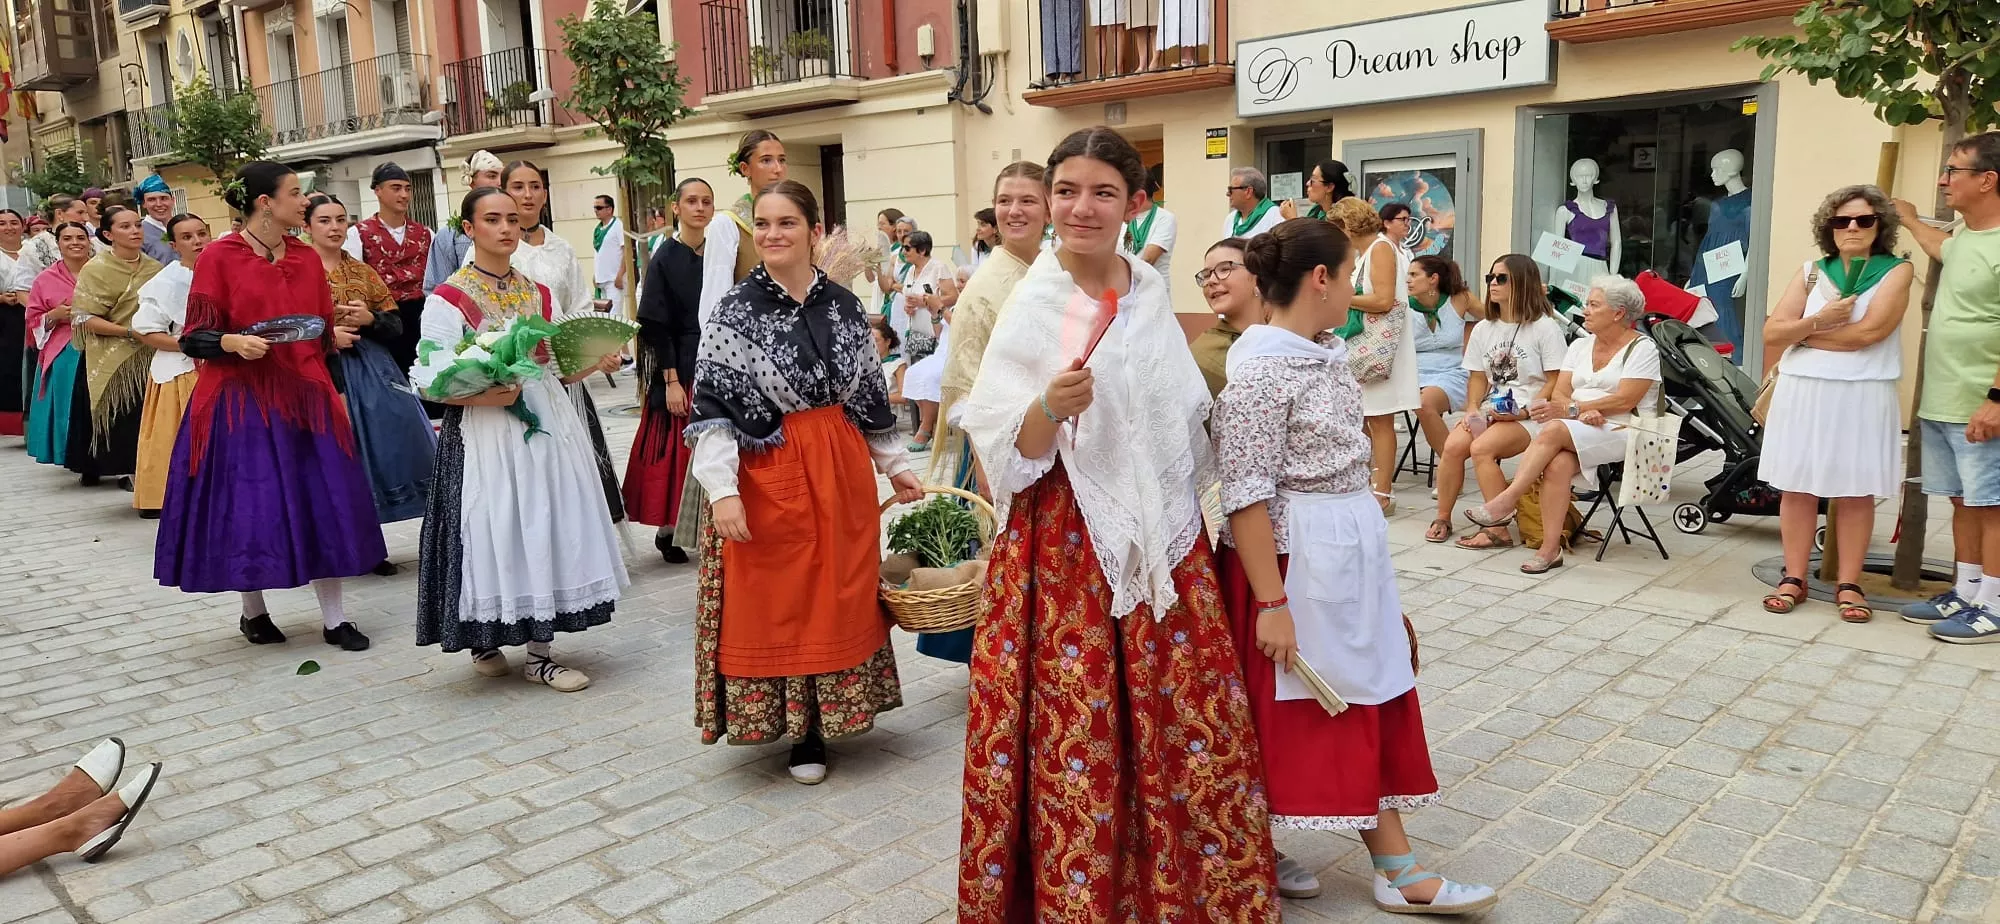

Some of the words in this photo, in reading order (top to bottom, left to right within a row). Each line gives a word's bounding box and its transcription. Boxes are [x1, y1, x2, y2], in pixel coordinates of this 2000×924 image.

[1326, 39, 1439, 80] Dream
[1450, 19, 1527, 81] shop
[1107, 106, 1121, 121] 44
